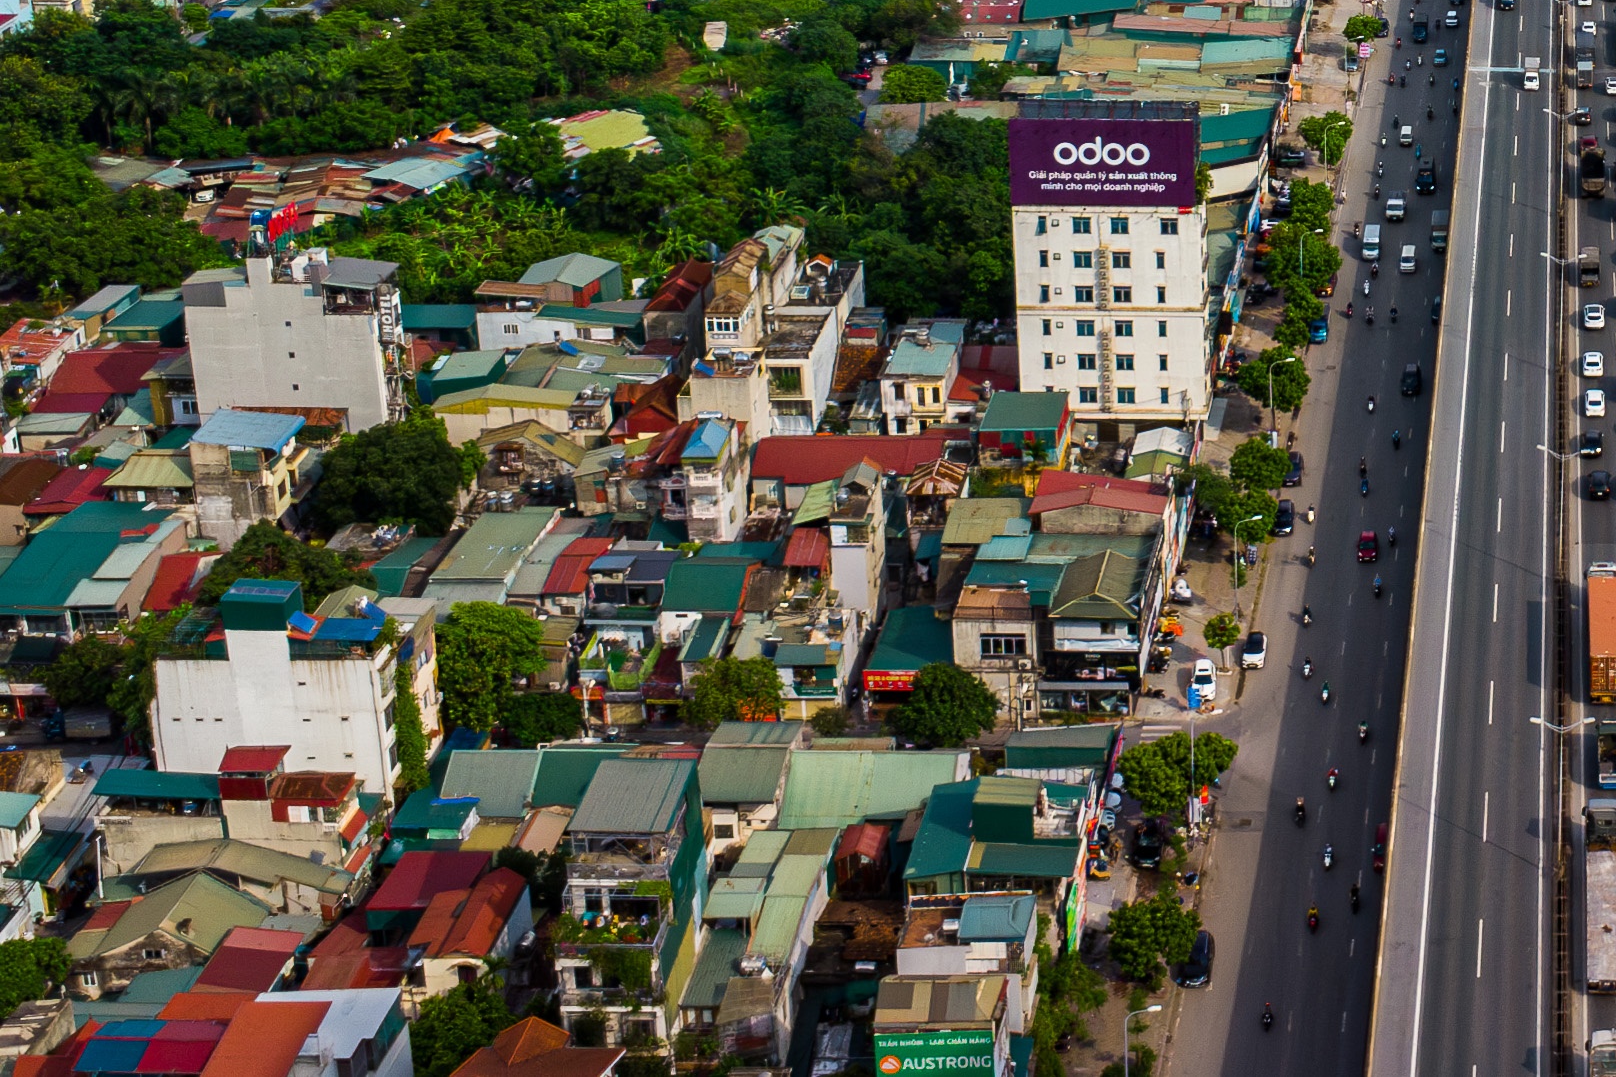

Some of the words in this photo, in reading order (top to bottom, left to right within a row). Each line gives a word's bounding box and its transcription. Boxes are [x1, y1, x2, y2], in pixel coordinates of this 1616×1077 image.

[1053, 136, 1150, 166] odoo
[1028, 170, 1047, 179] Giải
[1048, 170, 1072, 181] pháp
[1073, 170, 1097, 181] quản
[1098, 171, 1107, 181] lý
[1108, 170, 1126, 180] sản
[1065, 182, 1083, 190] cho
[1084, 182, 1102, 192] mọi
[1103, 182, 1132, 191] doanh
[1133, 182, 1166, 193] nghiệp
[380, 293, 393, 333] HOTEL
[902, 1055, 992, 1070] AUSTRONG
